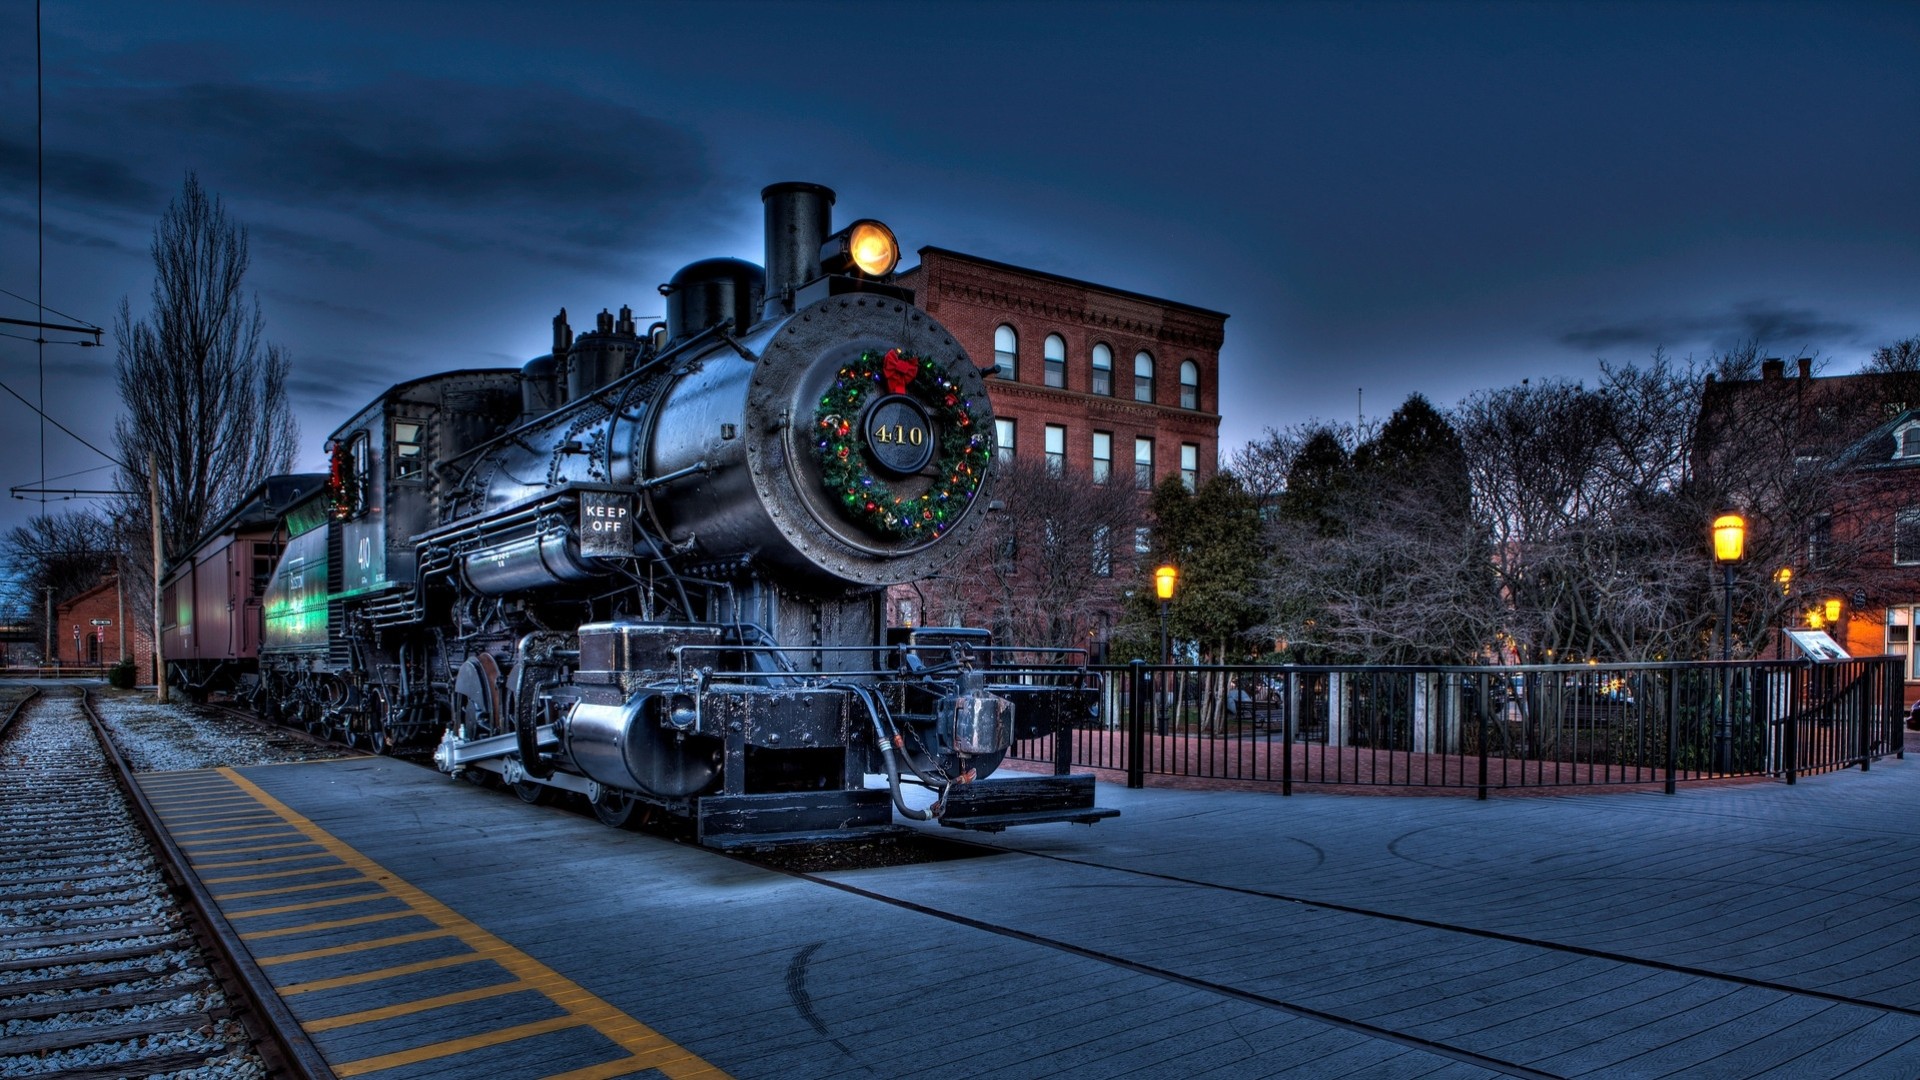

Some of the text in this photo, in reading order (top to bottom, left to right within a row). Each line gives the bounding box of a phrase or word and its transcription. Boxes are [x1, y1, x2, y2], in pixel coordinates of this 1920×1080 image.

[875, 424, 922, 446] 410
[586, 506, 627, 518] KEEP
[592, 520, 622, 532] OFF
